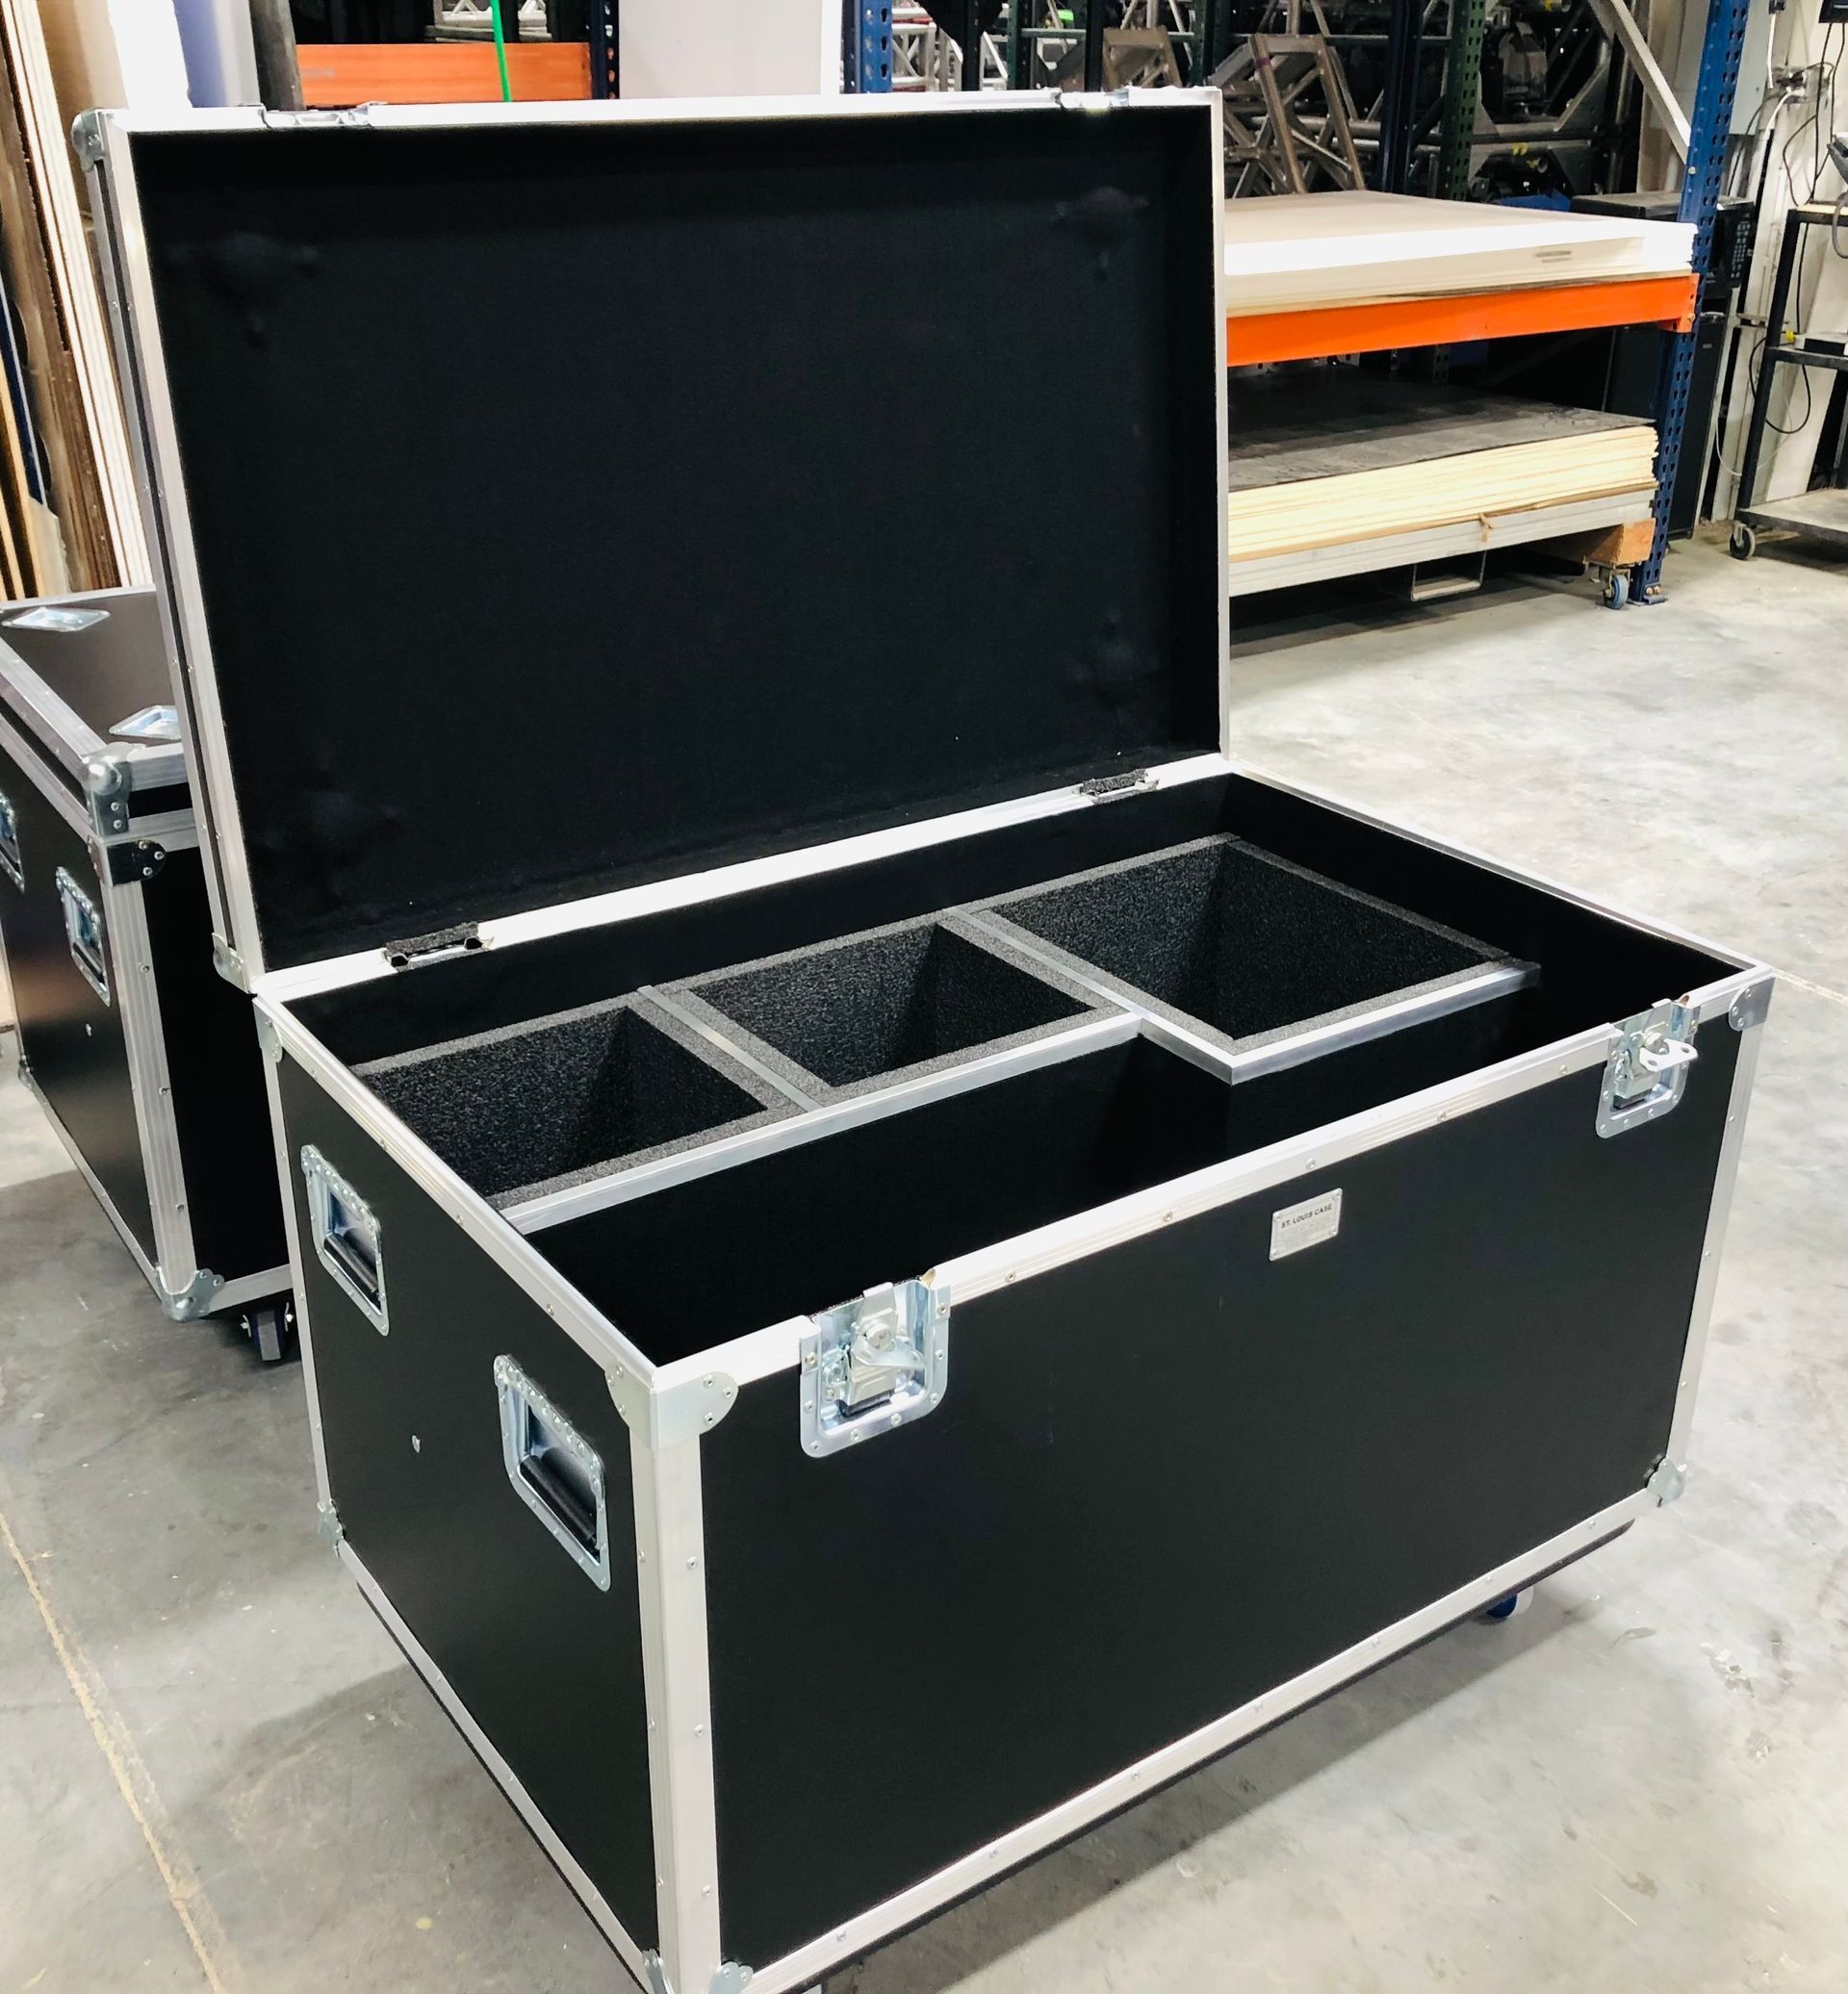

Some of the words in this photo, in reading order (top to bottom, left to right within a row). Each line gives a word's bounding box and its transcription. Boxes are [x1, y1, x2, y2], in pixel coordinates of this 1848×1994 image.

[1281, 1218, 1292, 1229] ST.
[1293, 1211, 1313, 1223] LOUIS
[1314, 1203, 1332, 1215] CASE
